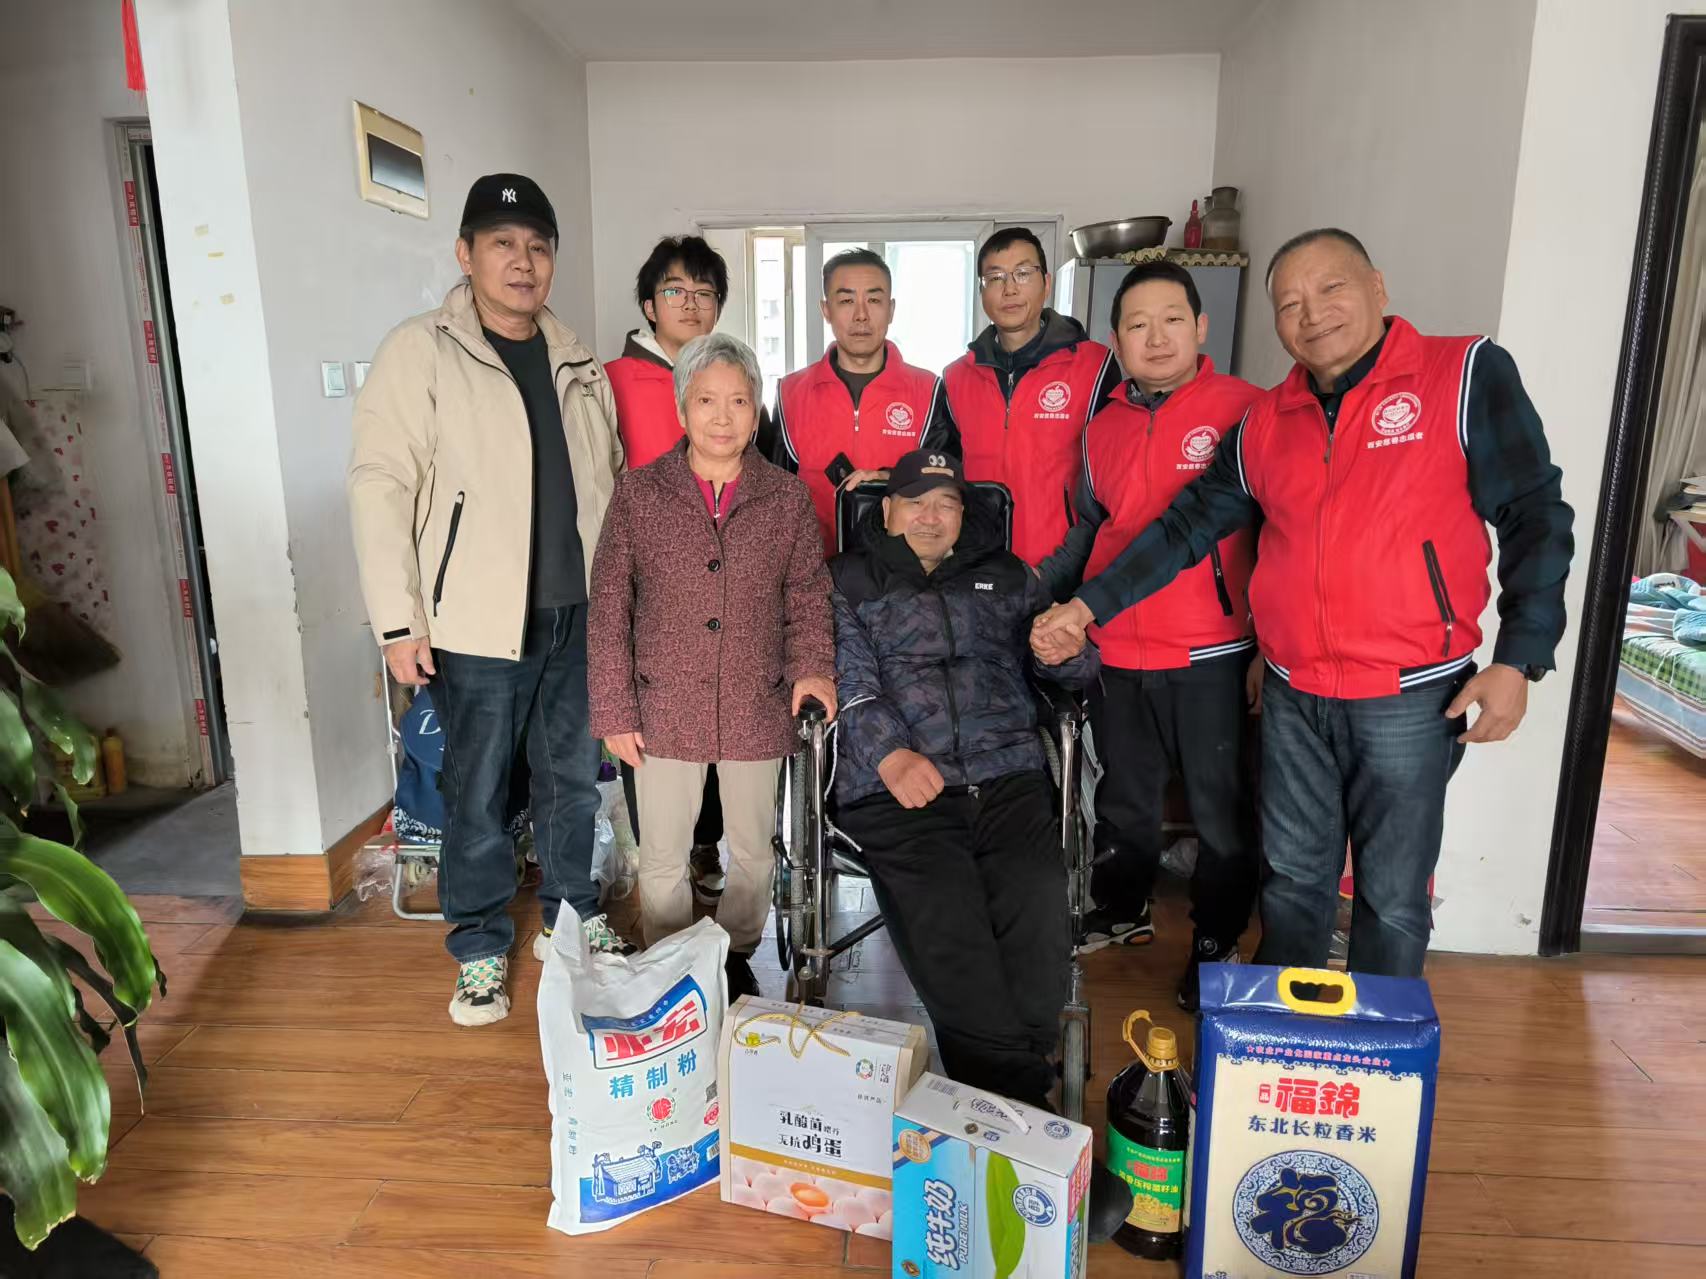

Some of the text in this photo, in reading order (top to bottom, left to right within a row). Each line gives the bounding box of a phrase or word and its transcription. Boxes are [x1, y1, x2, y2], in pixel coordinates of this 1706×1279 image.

[502, 188, 517, 203] NY
[609, 1048, 697, 1099] 精制粉
[1248, 1115, 1377, 1144] 东北长粒香米
[924, 1178, 960, 1270] 纯牛奶
[958, 1202, 968, 1264] PURE MILK
